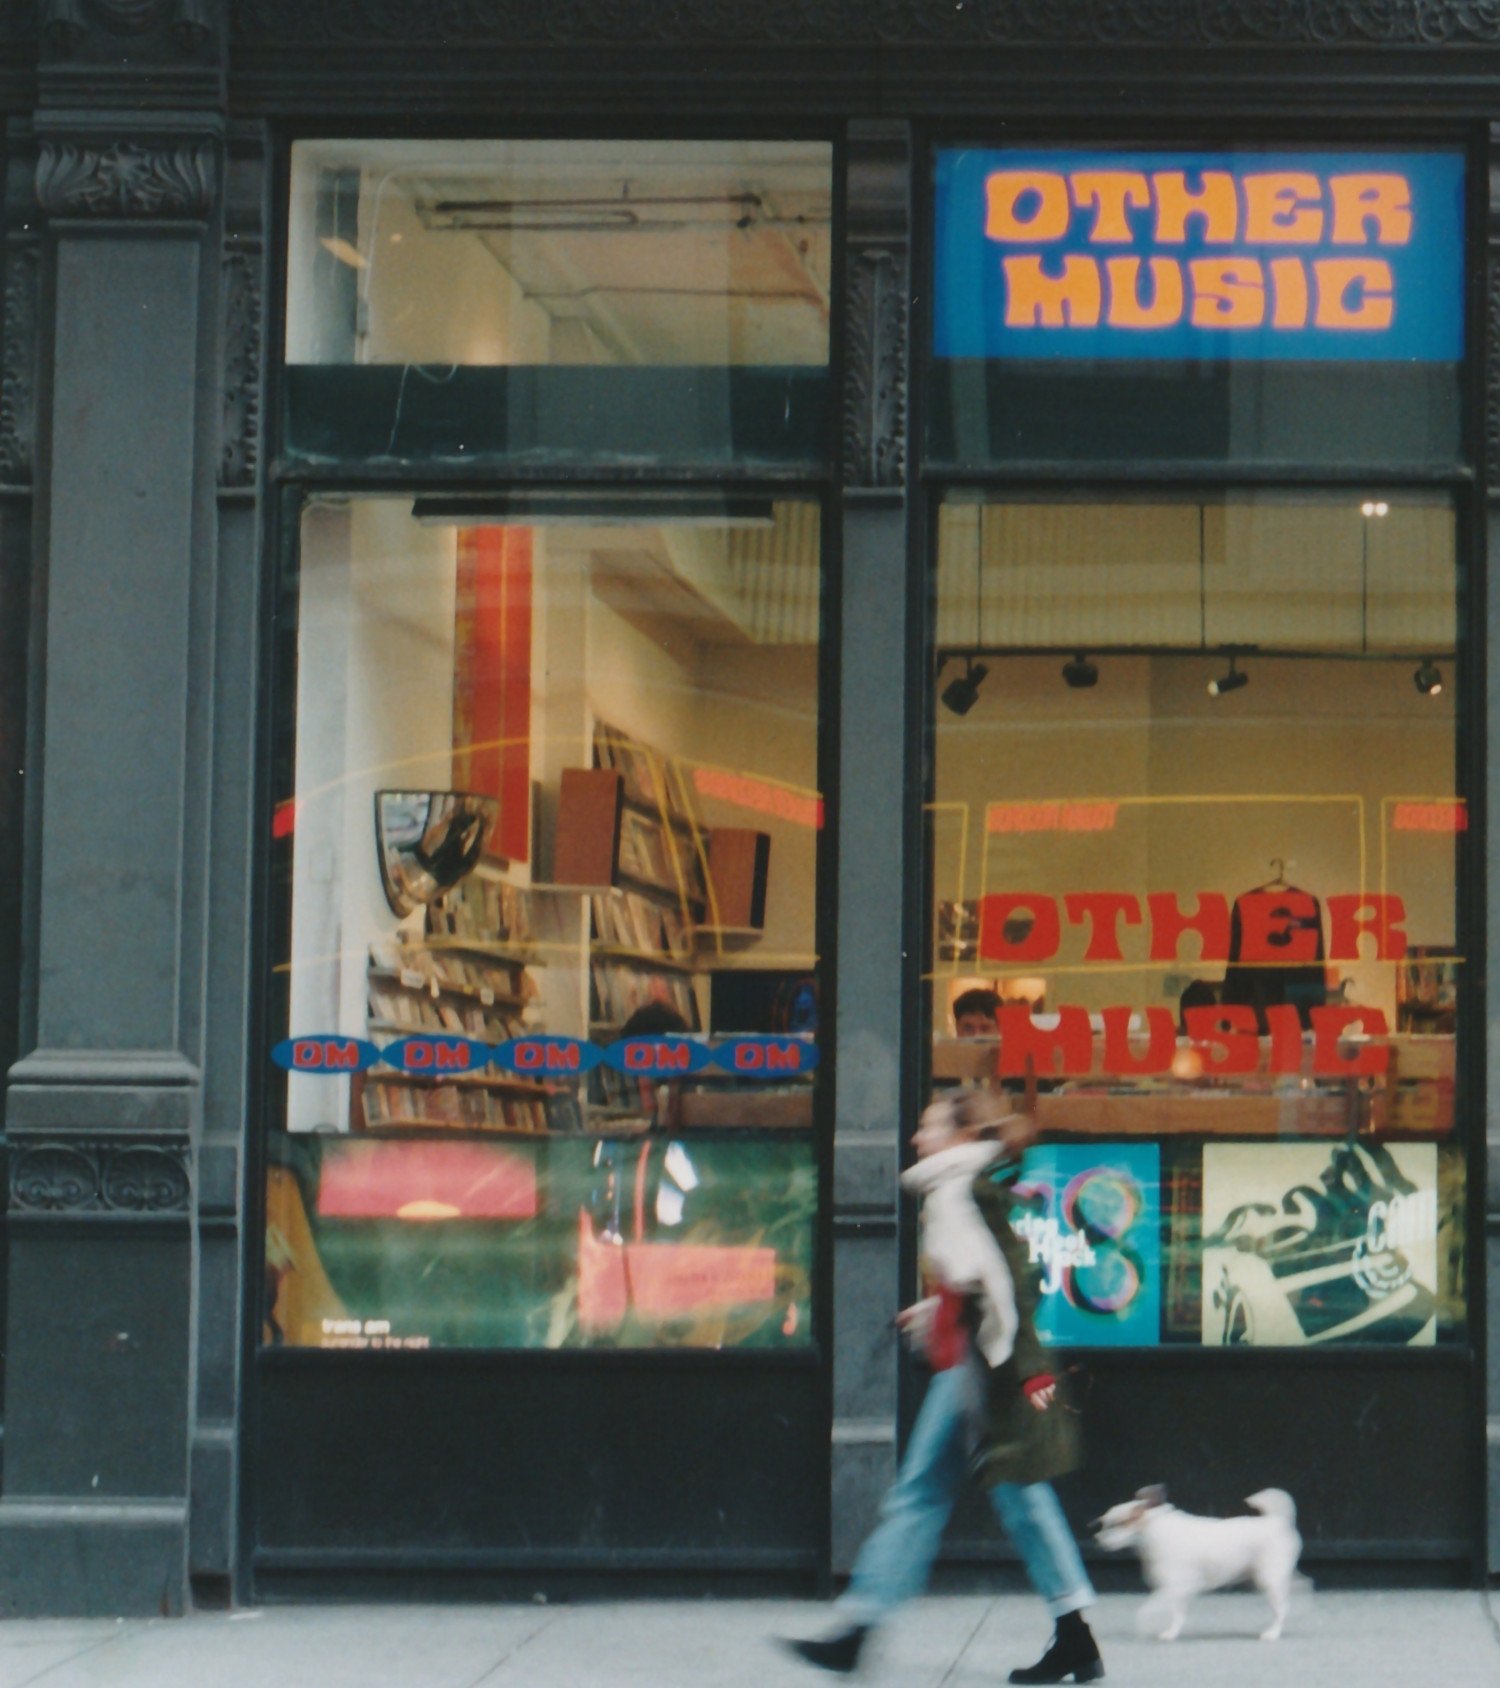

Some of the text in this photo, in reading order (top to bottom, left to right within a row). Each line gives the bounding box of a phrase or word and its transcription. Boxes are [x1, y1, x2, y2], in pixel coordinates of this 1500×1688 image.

[984, 169, 1413, 245] OTHER
[1002, 253, 1396, 330] MUSIC
[977, 891, 1408, 963] OTHER
[293, 1042, 801, 1069] OM OM OM OM OM
[995, 1004, 1391, 1077] MUSIC
